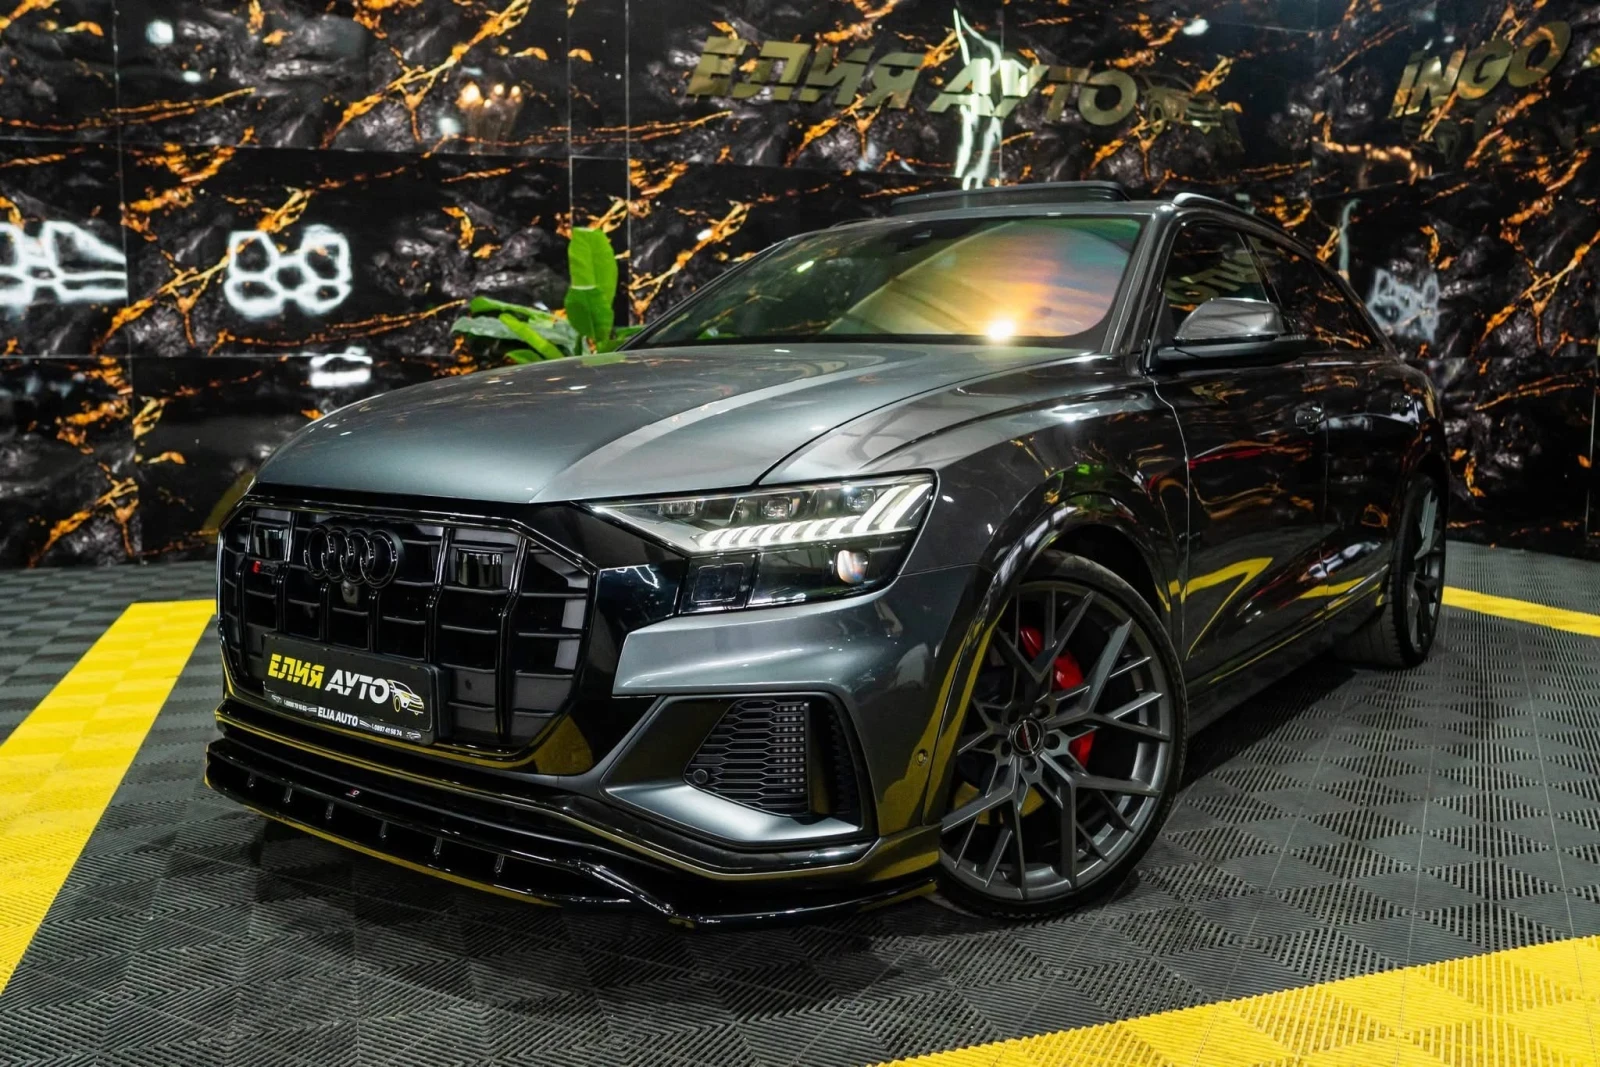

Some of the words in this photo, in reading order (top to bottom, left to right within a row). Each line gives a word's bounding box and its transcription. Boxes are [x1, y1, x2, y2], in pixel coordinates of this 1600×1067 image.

[686, 36, 923, 109] ЕЛИЯ
[268, 653, 325, 689] ЕЛИЯ
[325, 669, 389, 704] АУТО
[318, 707, 335, 720] ELIA
[336, 713, 358, 727] AUTO
